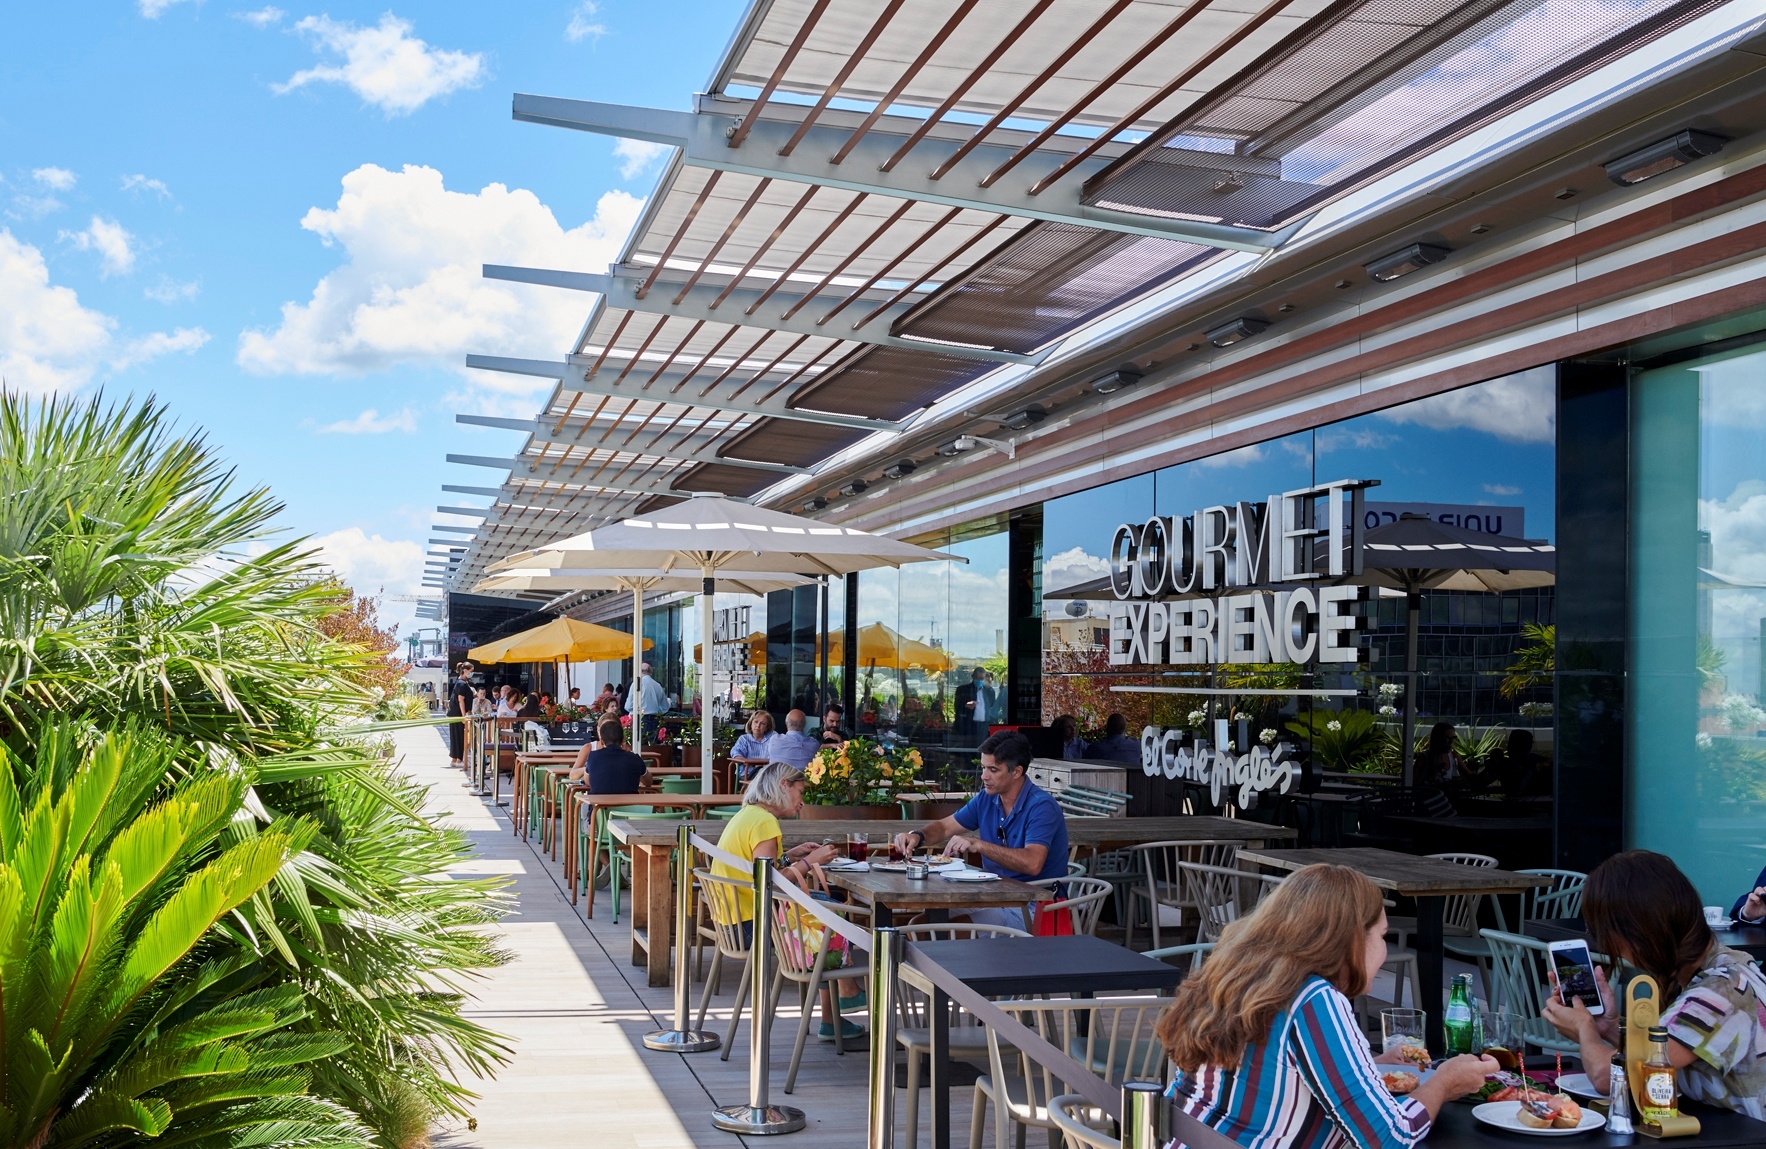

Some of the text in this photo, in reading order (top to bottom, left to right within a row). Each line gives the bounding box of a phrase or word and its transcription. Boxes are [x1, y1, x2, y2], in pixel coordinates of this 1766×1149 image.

[1111, 479, 1359, 600] GOURMET
[1109, 585, 1359, 666] EXPERIENCE
[1141, 719, 1300, 810] El Corte Inglés
